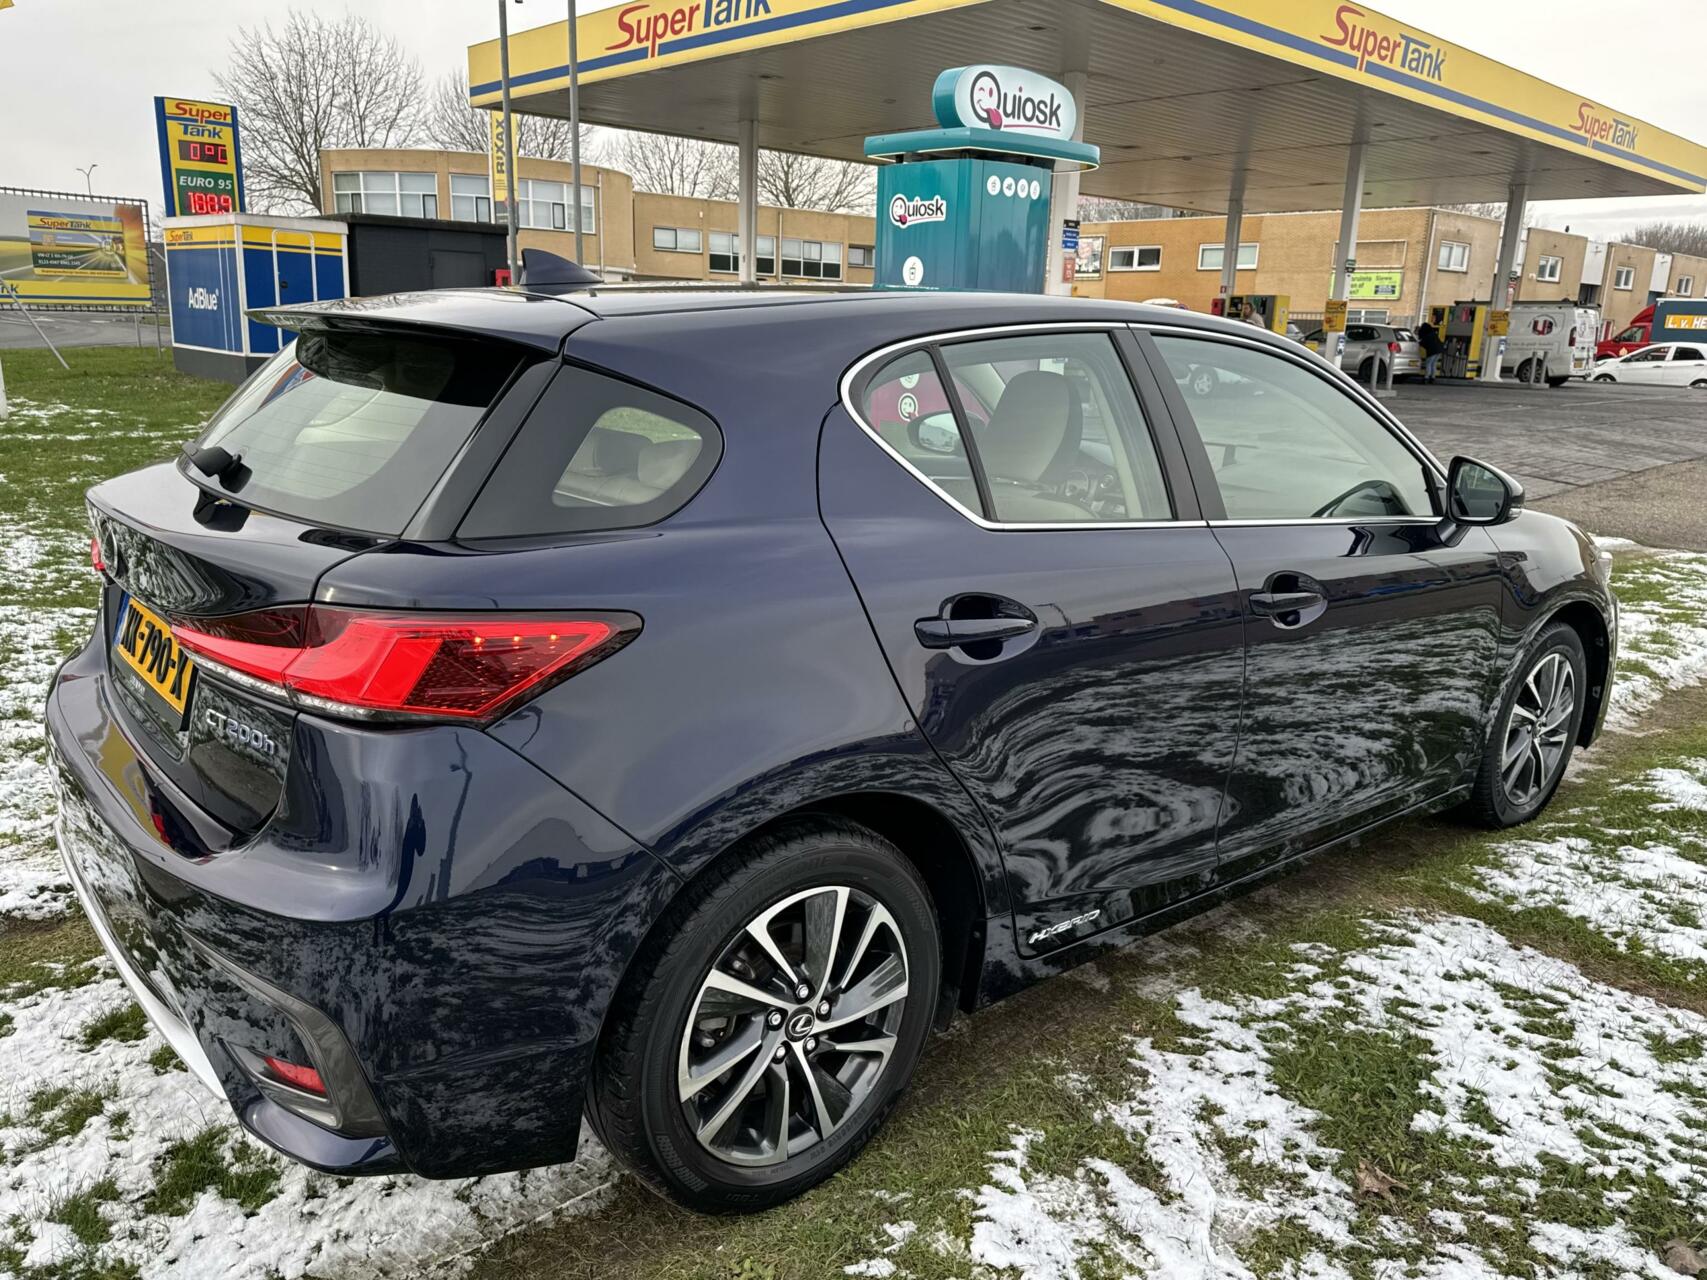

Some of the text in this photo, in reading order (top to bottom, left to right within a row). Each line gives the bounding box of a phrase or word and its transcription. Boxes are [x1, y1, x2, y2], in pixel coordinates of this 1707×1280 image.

[1320, 5, 1446, 81] SuperTank
[166, 101, 230, 124] Super
[970, 71, 1061, 130] Quiosk
[178, 122, 223, 140] Tank
[1569, 102, 1638, 150] SuperTank
[179, 176, 232, 190] EURO 95
[891, 197, 944, 225] Quiosk
